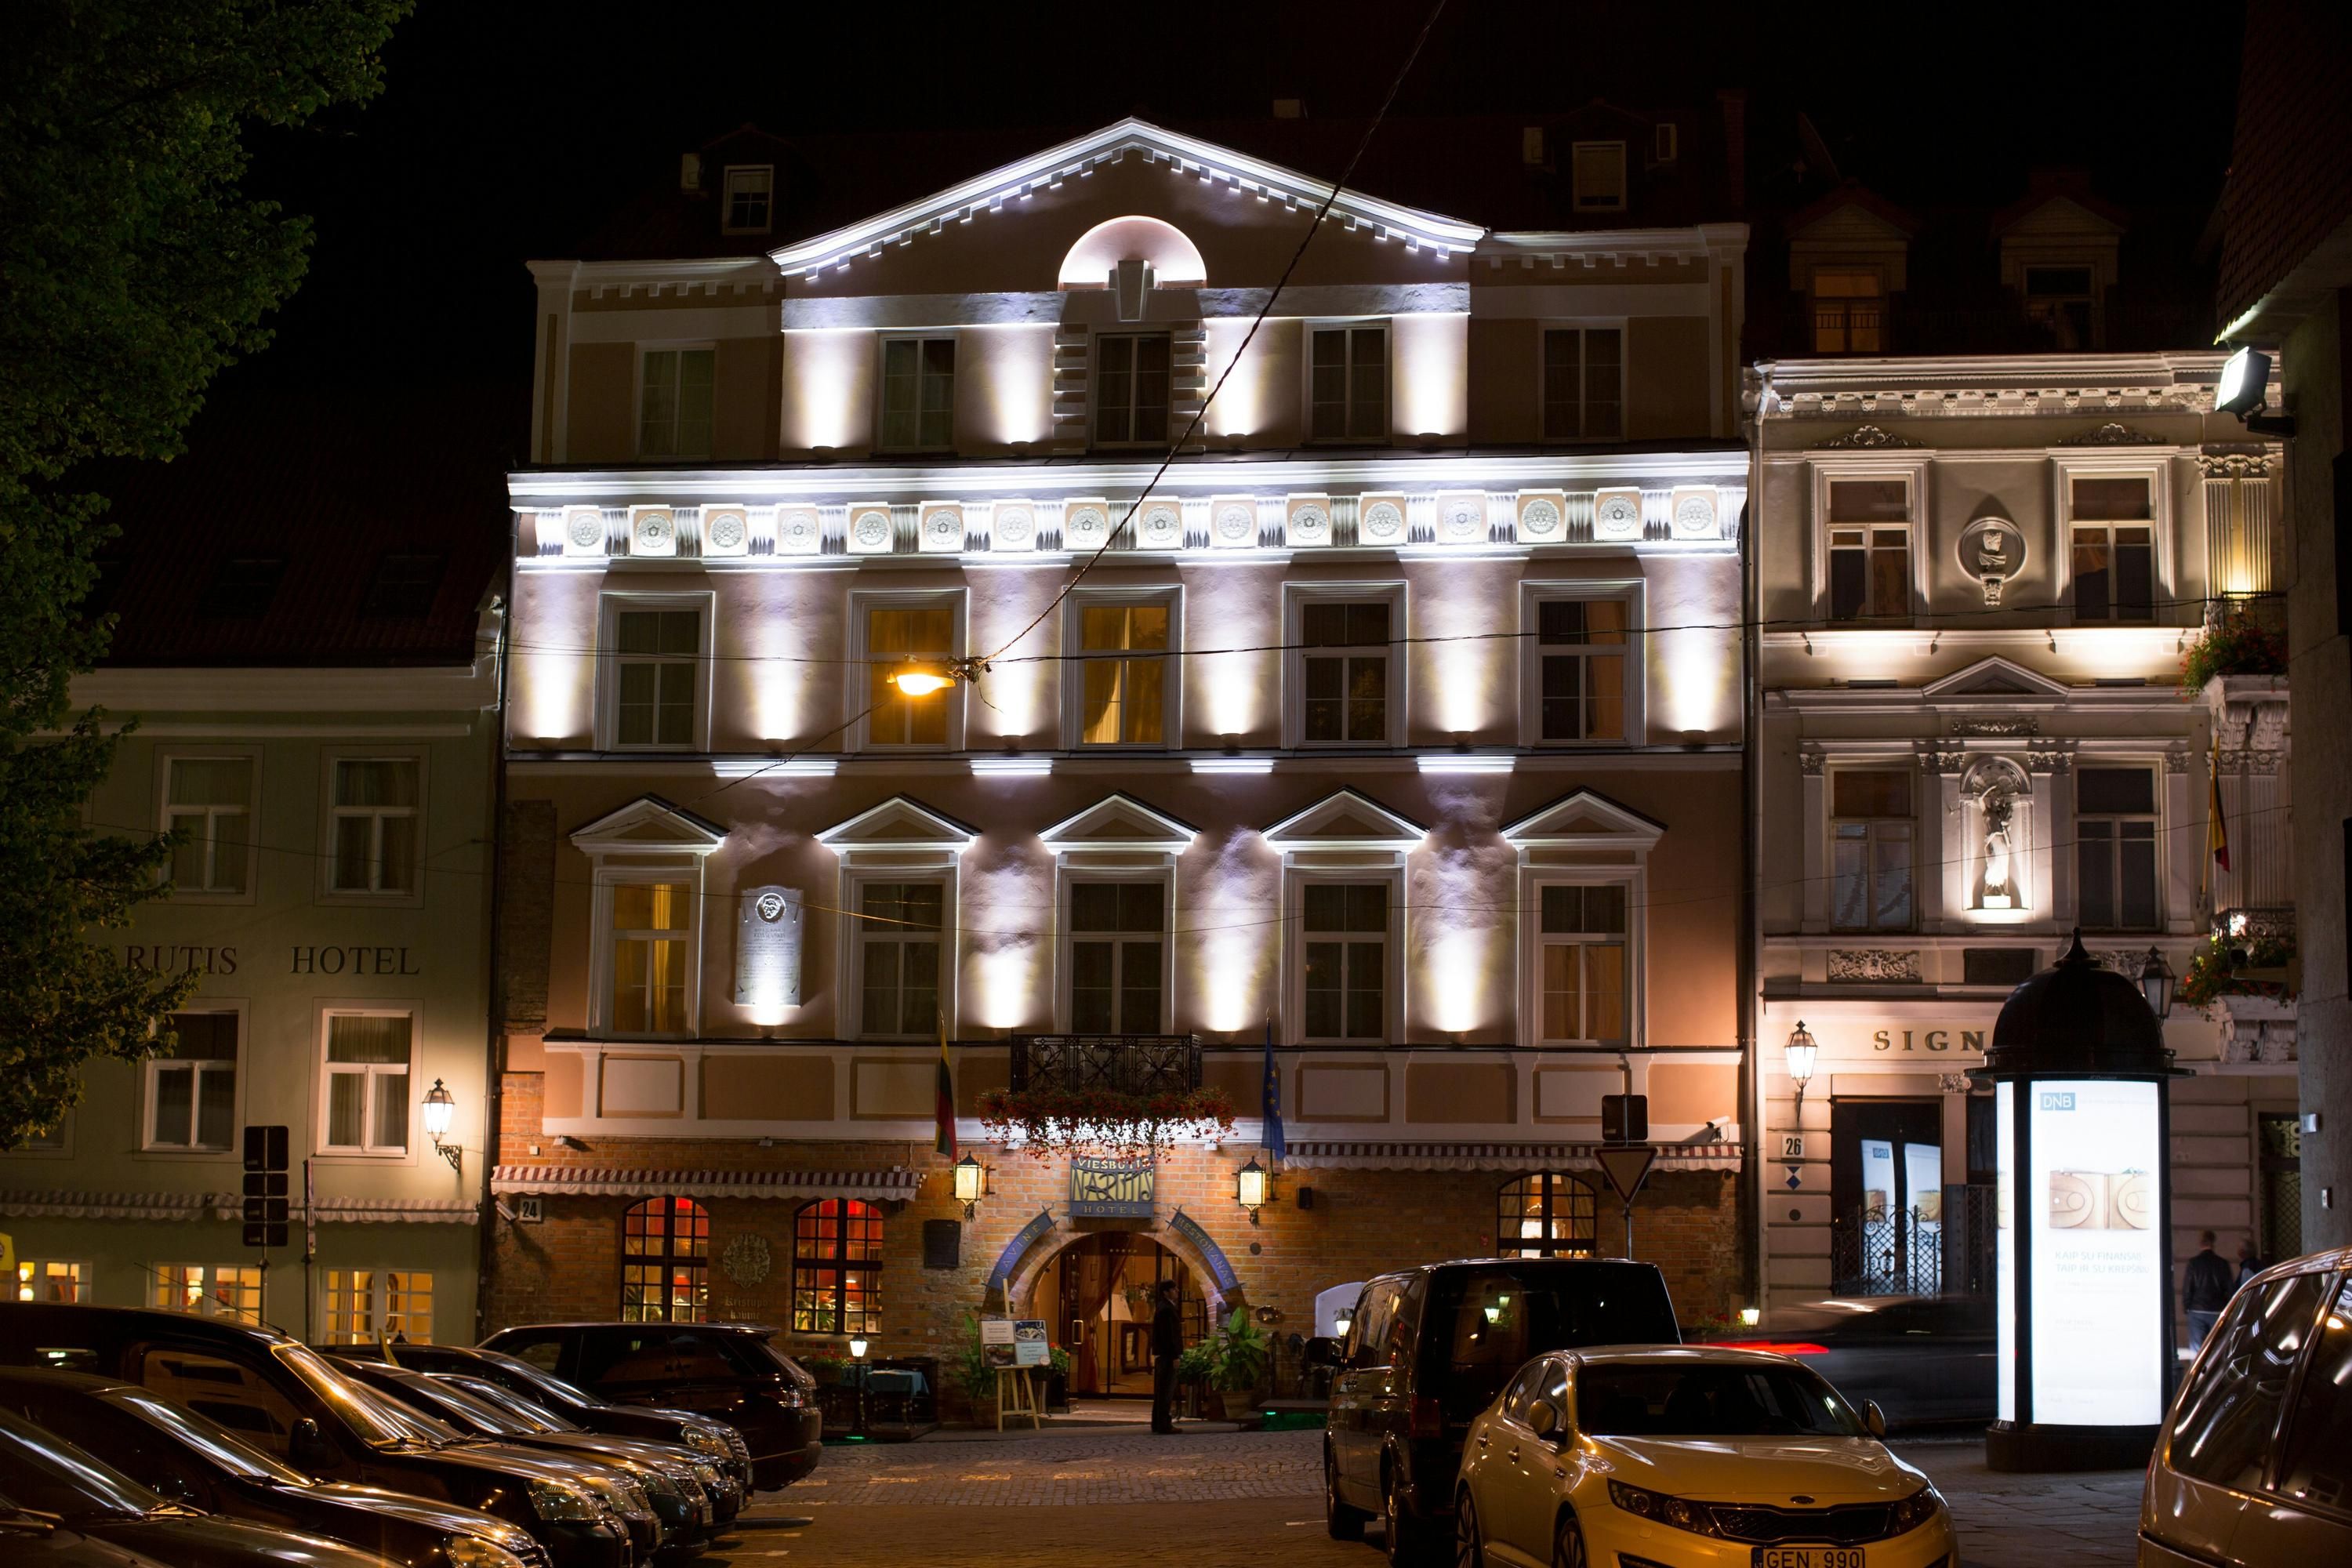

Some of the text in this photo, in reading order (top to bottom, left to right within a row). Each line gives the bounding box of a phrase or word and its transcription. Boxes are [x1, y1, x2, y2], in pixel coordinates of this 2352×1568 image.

[125, 946, 420, 975] RUTIS HOTEL
[1873, 1030, 1986, 1051] SIGN
[2043, 1092, 2072, 1111] DNB
[1785, 1138, 1802, 1155] 26
[522, 1201, 538, 1218] 24
[1083, 1205, 1139, 1214] HOTEL
[1175, 1217, 1235, 1285] RESTORANAS
[2055, 1250, 2078, 1261] KAIP
[2082, 1250, 2095, 1261] SU
[1766, 1551, 1809, 1568] GEN
[1823, 1551, 1860, 1568] 990
